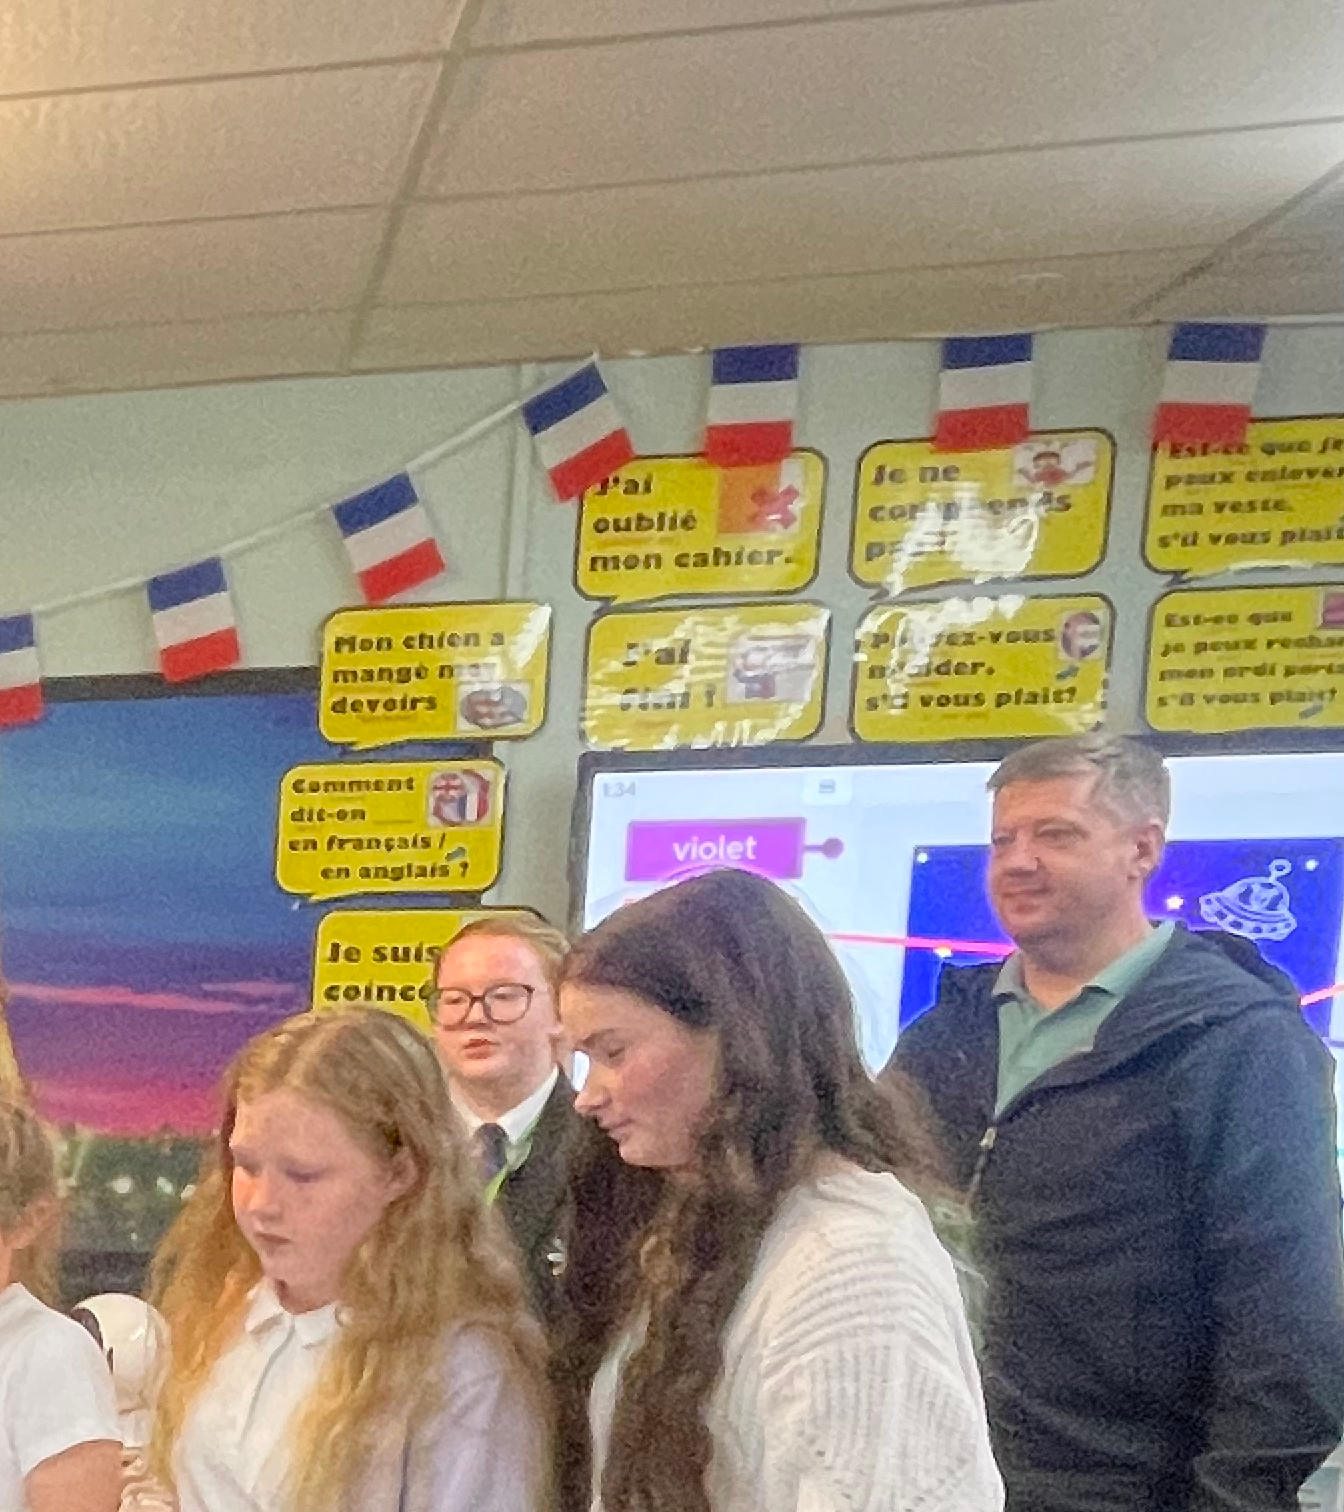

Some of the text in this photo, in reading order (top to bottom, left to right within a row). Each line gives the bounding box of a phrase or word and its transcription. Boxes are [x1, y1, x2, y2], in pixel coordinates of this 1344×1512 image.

[871, 464, 960, 487] Je ne
[1165, 470, 1235, 491] peux
[1161, 502, 1204, 517] ma
[592, 510, 698, 534] oublié
[1208, 530, 1272, 546] vous
[589, 546, 794, 572] mon cahier.
[333, 630, 506, 654] Mon chien a
[331, 664, 430, 685] mangé
[330, 693, 438, 715] devoirs
[919, 691, 986, 707] vous
[1202, 692, 1260, 705] vous
[291, 776, 415, 794] Comment
[290, 806, 367, 823] dit-on
[288, 837, 318, 852] en
[326, 832, 432, 852] français
[672, 834, 758, 862] violet
[320, 865, 351, 880] en
[358, 861, 450, 882] anglais
[327, 940, 444, 964] Je suis
